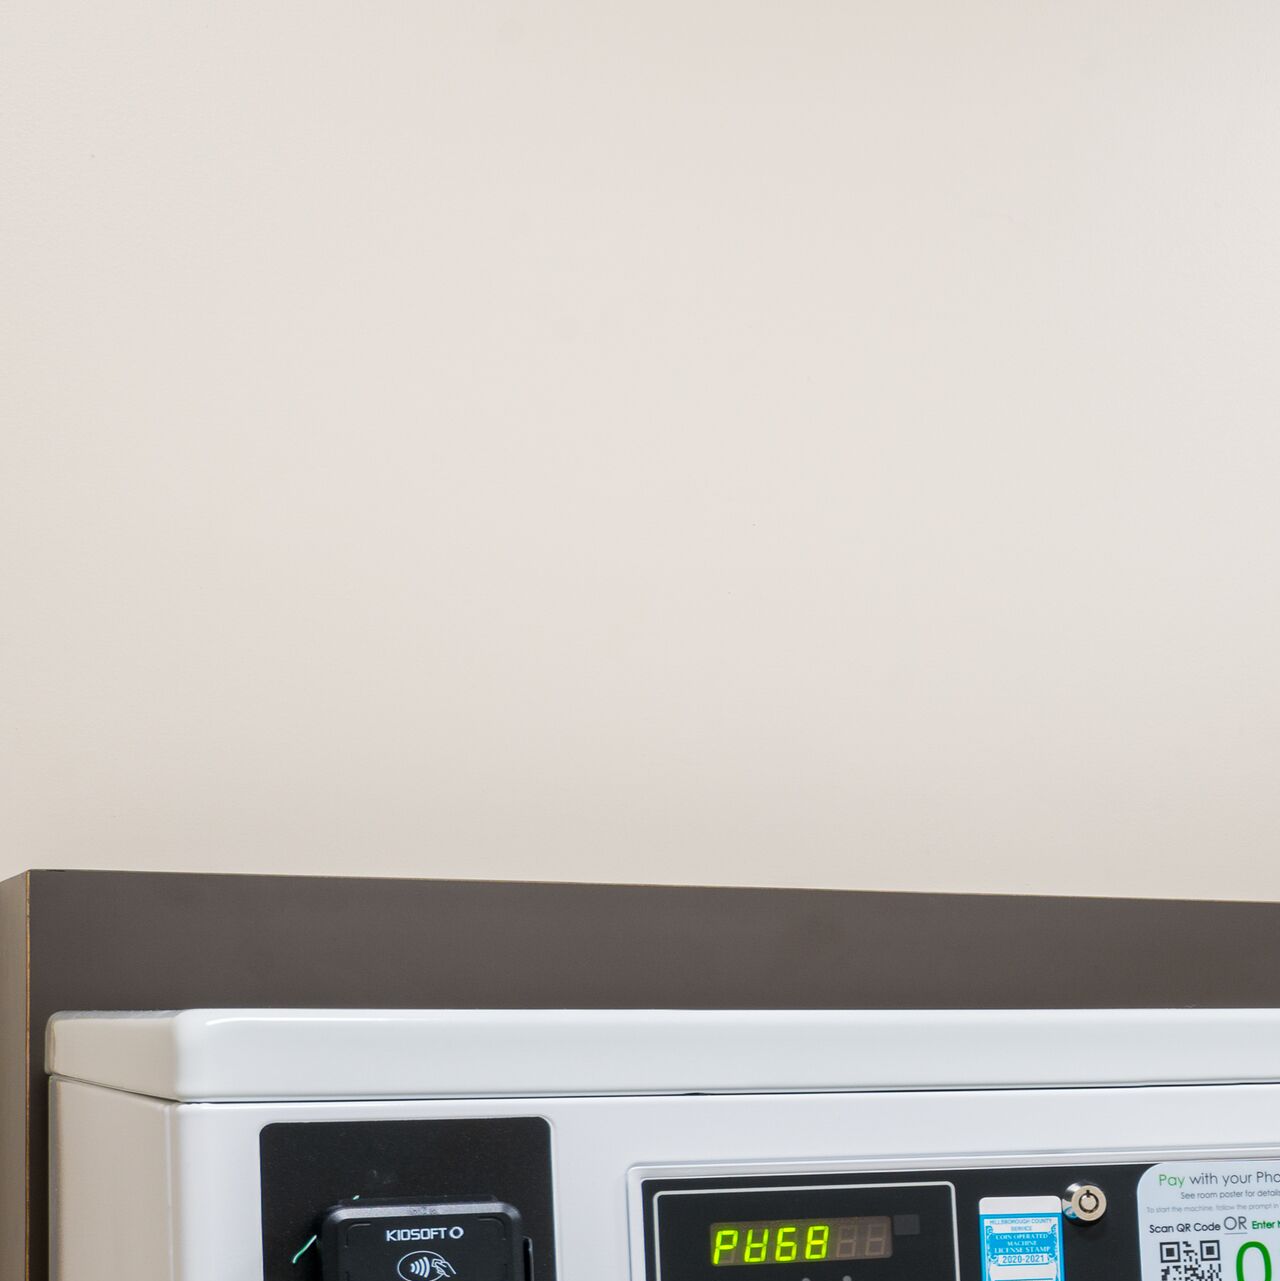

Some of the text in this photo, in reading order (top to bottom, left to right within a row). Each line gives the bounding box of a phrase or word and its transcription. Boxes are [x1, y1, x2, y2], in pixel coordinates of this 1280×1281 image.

[1159, 1174, 1185, 1188] Pay
[1190, 1172, 1218, 1185] with
[1222, 1173, 1251, 1187] your
[1181, 1191, 1195, 1200] See
[1219, 1190, 1243, 1199] poster
[1149, 1224, 1174, 1234] Scan
[1176, 1223, 1191, 1234] QR
[1193, 1221, 1221, 1232] Code
[1223, 1216, 1248, 1231] OR
[1252, 1220, 1275, 1230] Enter
[386, 1227, 447, 1242] KIOSOFT
[1002, 1254, 1045, 1264] 2020-2021
